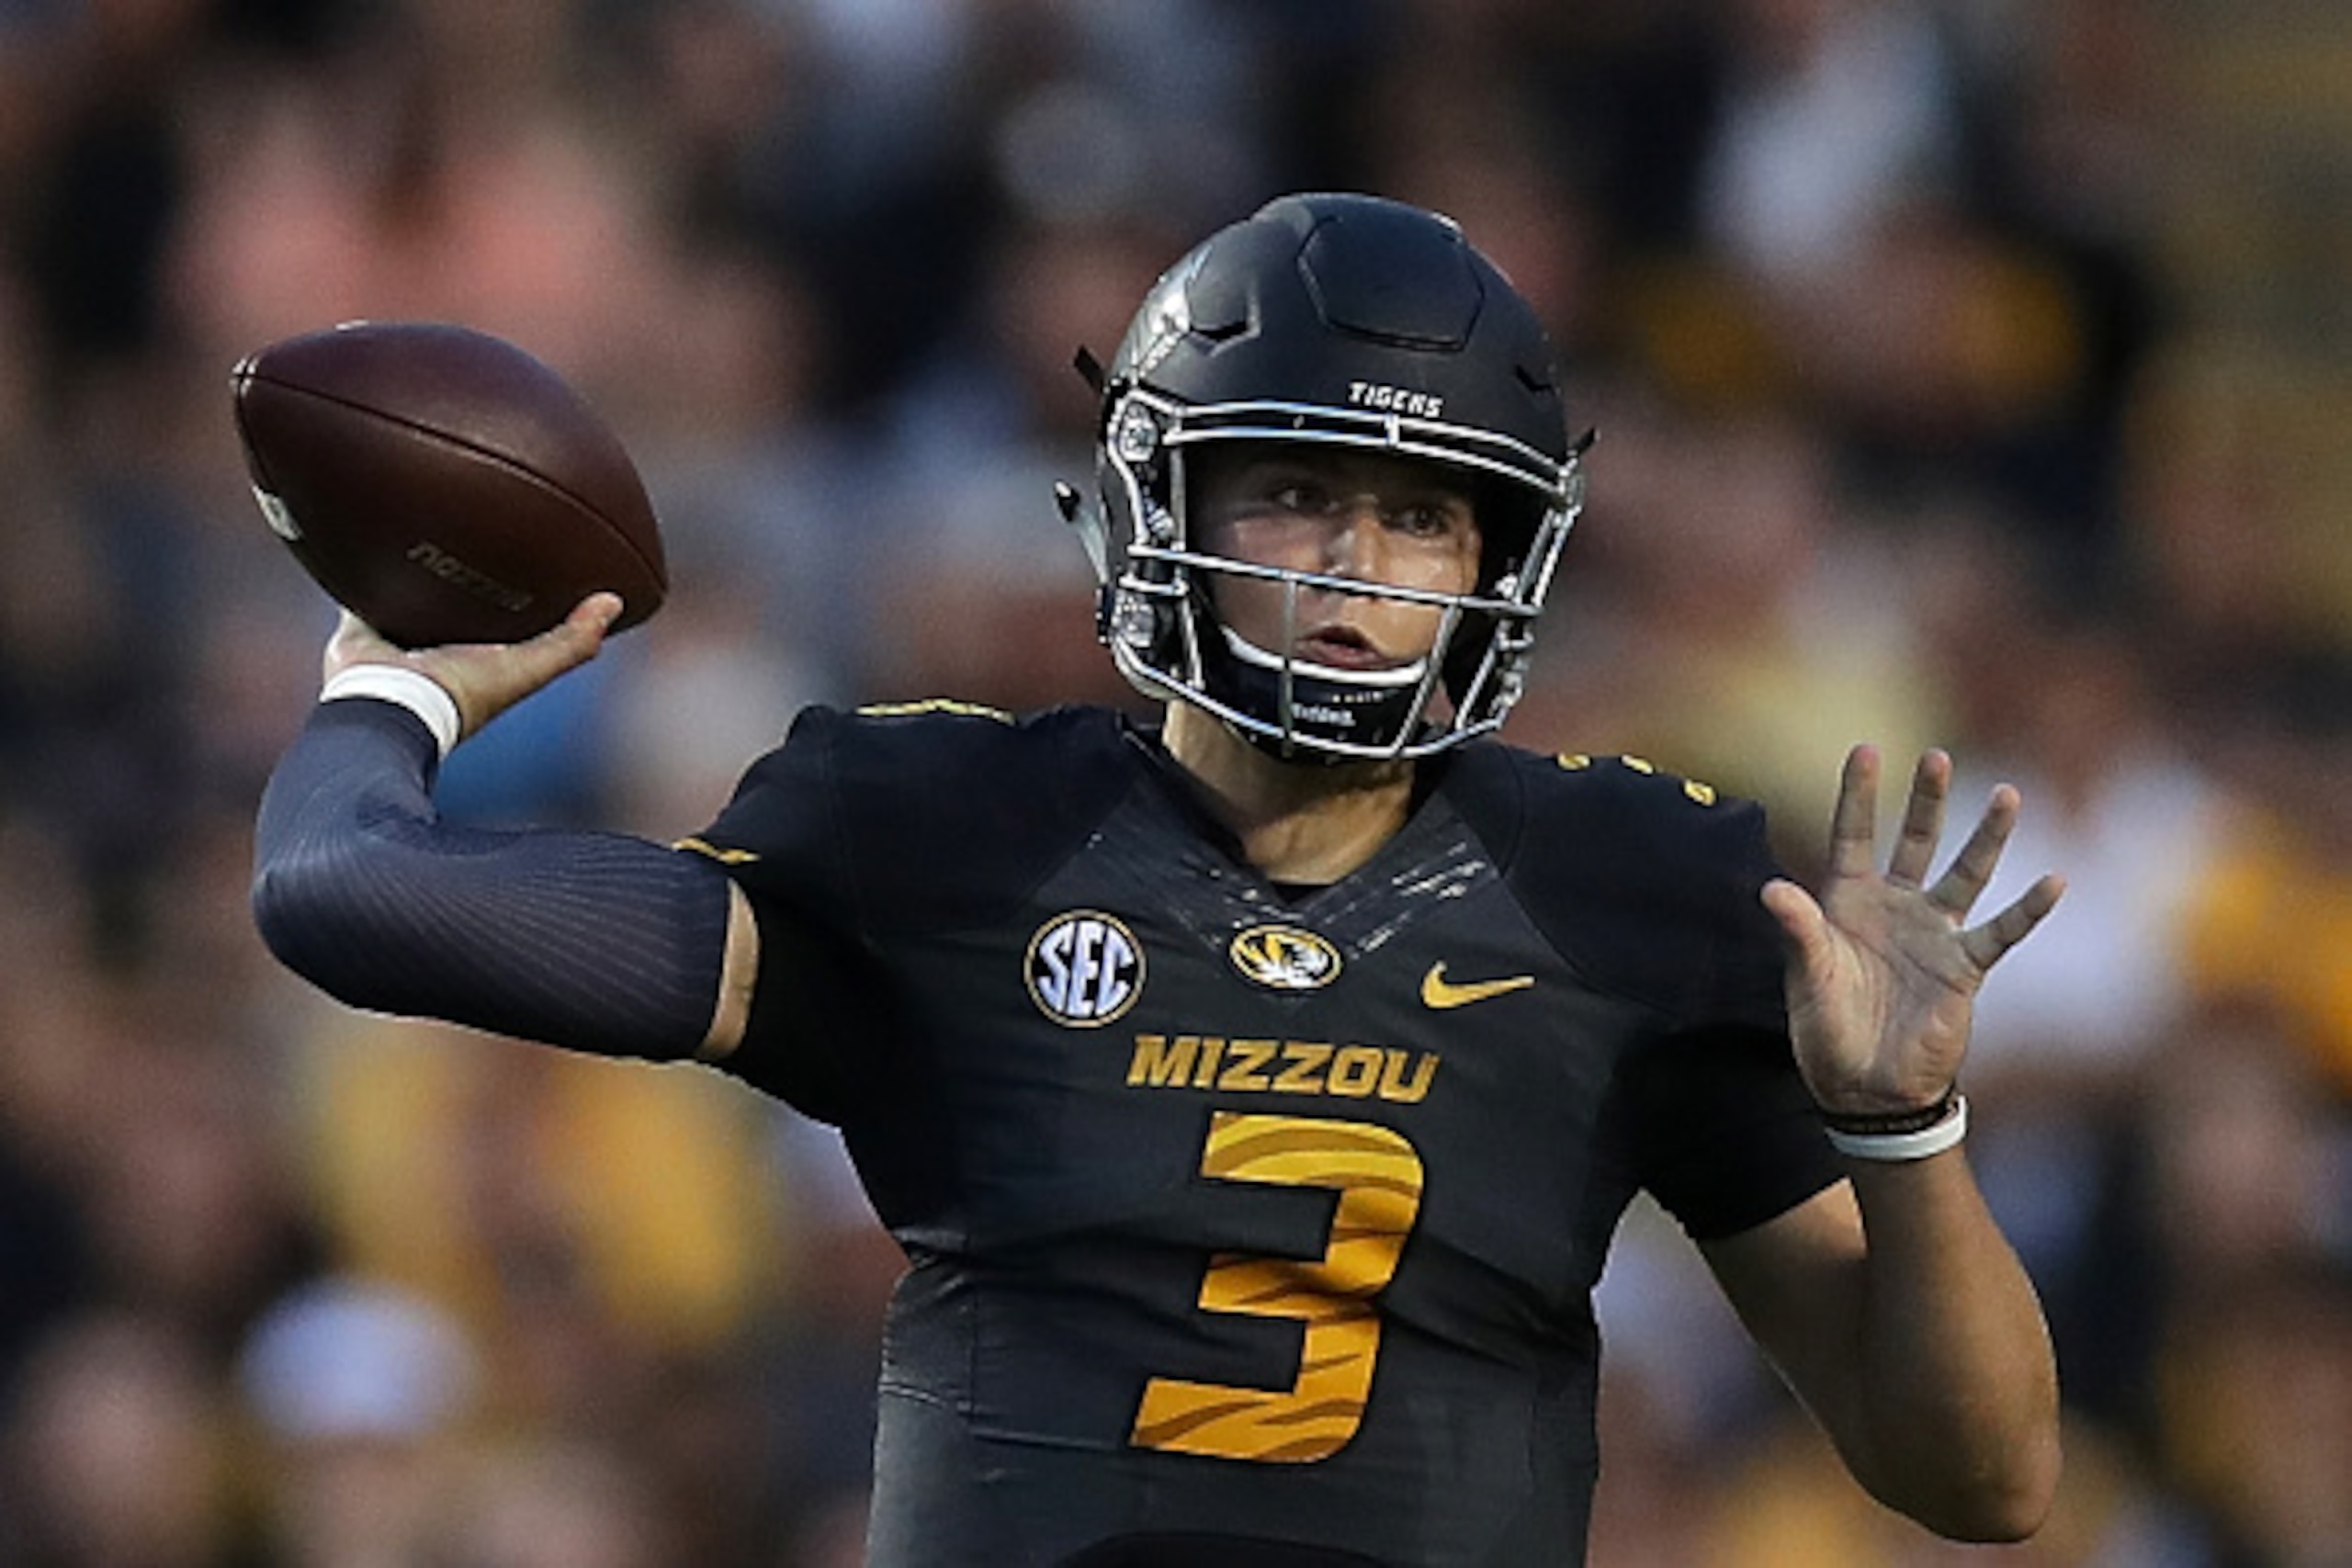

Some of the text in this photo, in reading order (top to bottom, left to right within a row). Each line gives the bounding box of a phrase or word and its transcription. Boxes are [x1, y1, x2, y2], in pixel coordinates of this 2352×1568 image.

[1347, 381, 1444, 418] TIGERS
[1037, 919, 1136, 1019] SEC
[1125, 1034, 1441, 1104] MIZZOU
[1129, 1110, 1424, 1463] 3
